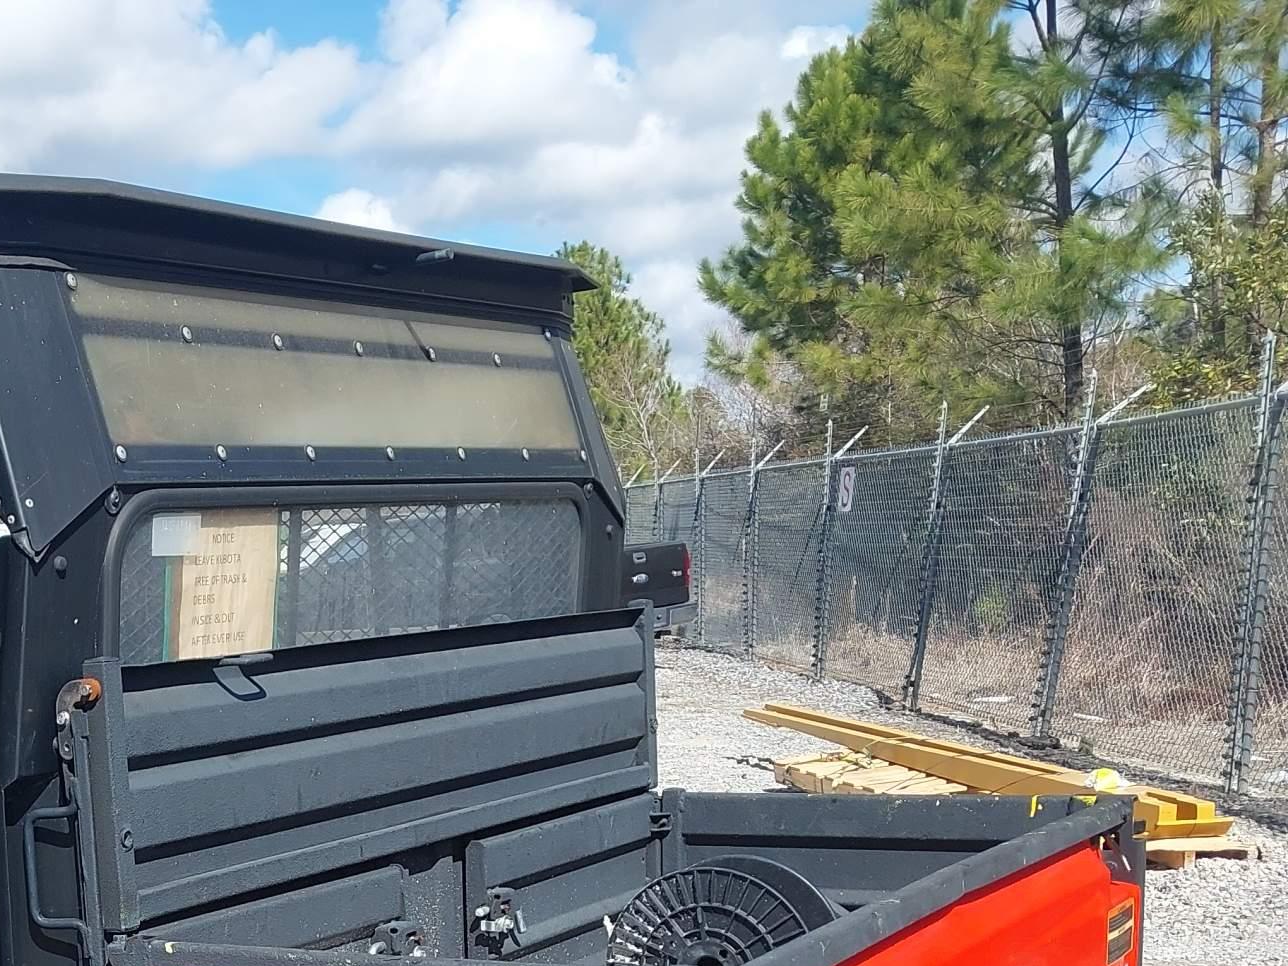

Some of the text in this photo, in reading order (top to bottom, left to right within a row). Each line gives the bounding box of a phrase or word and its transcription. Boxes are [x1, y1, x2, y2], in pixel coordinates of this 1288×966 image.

[841, 470, 851, 508] S
[212, 532, 235, 544] NOTICE
[194, 553, 241, 566] LEAVE KUBOTA
[211, 575, 220, 585] OF
[221, 612, 235, 623] OUT
